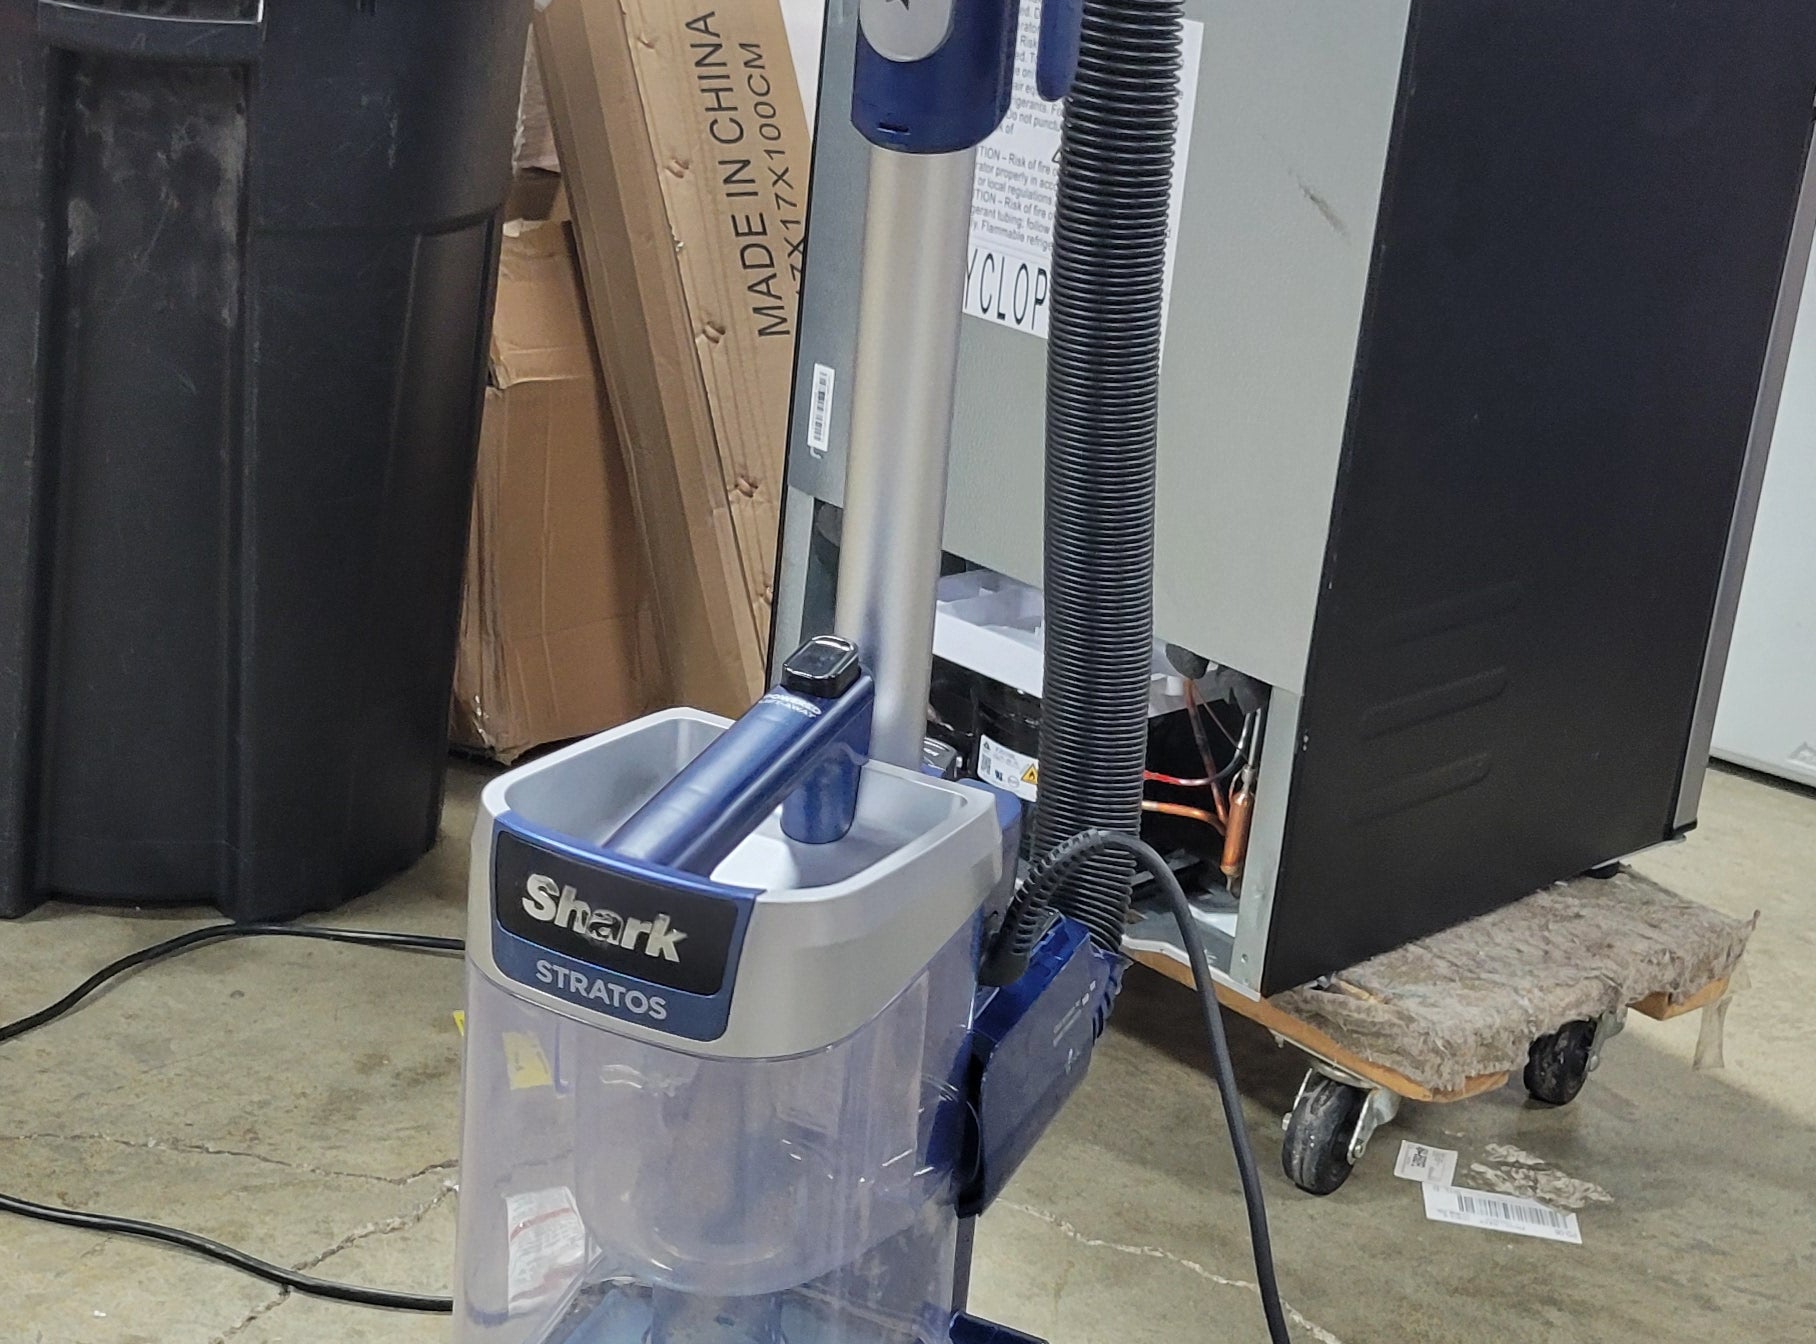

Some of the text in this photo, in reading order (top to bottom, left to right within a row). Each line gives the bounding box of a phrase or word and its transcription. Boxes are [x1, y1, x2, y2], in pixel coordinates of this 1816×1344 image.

[685, 11, 791, 338] MADE IN CHINA
[521, 873, 688, 963] Shark
[535, 959, 668, 1020] STRATOS
